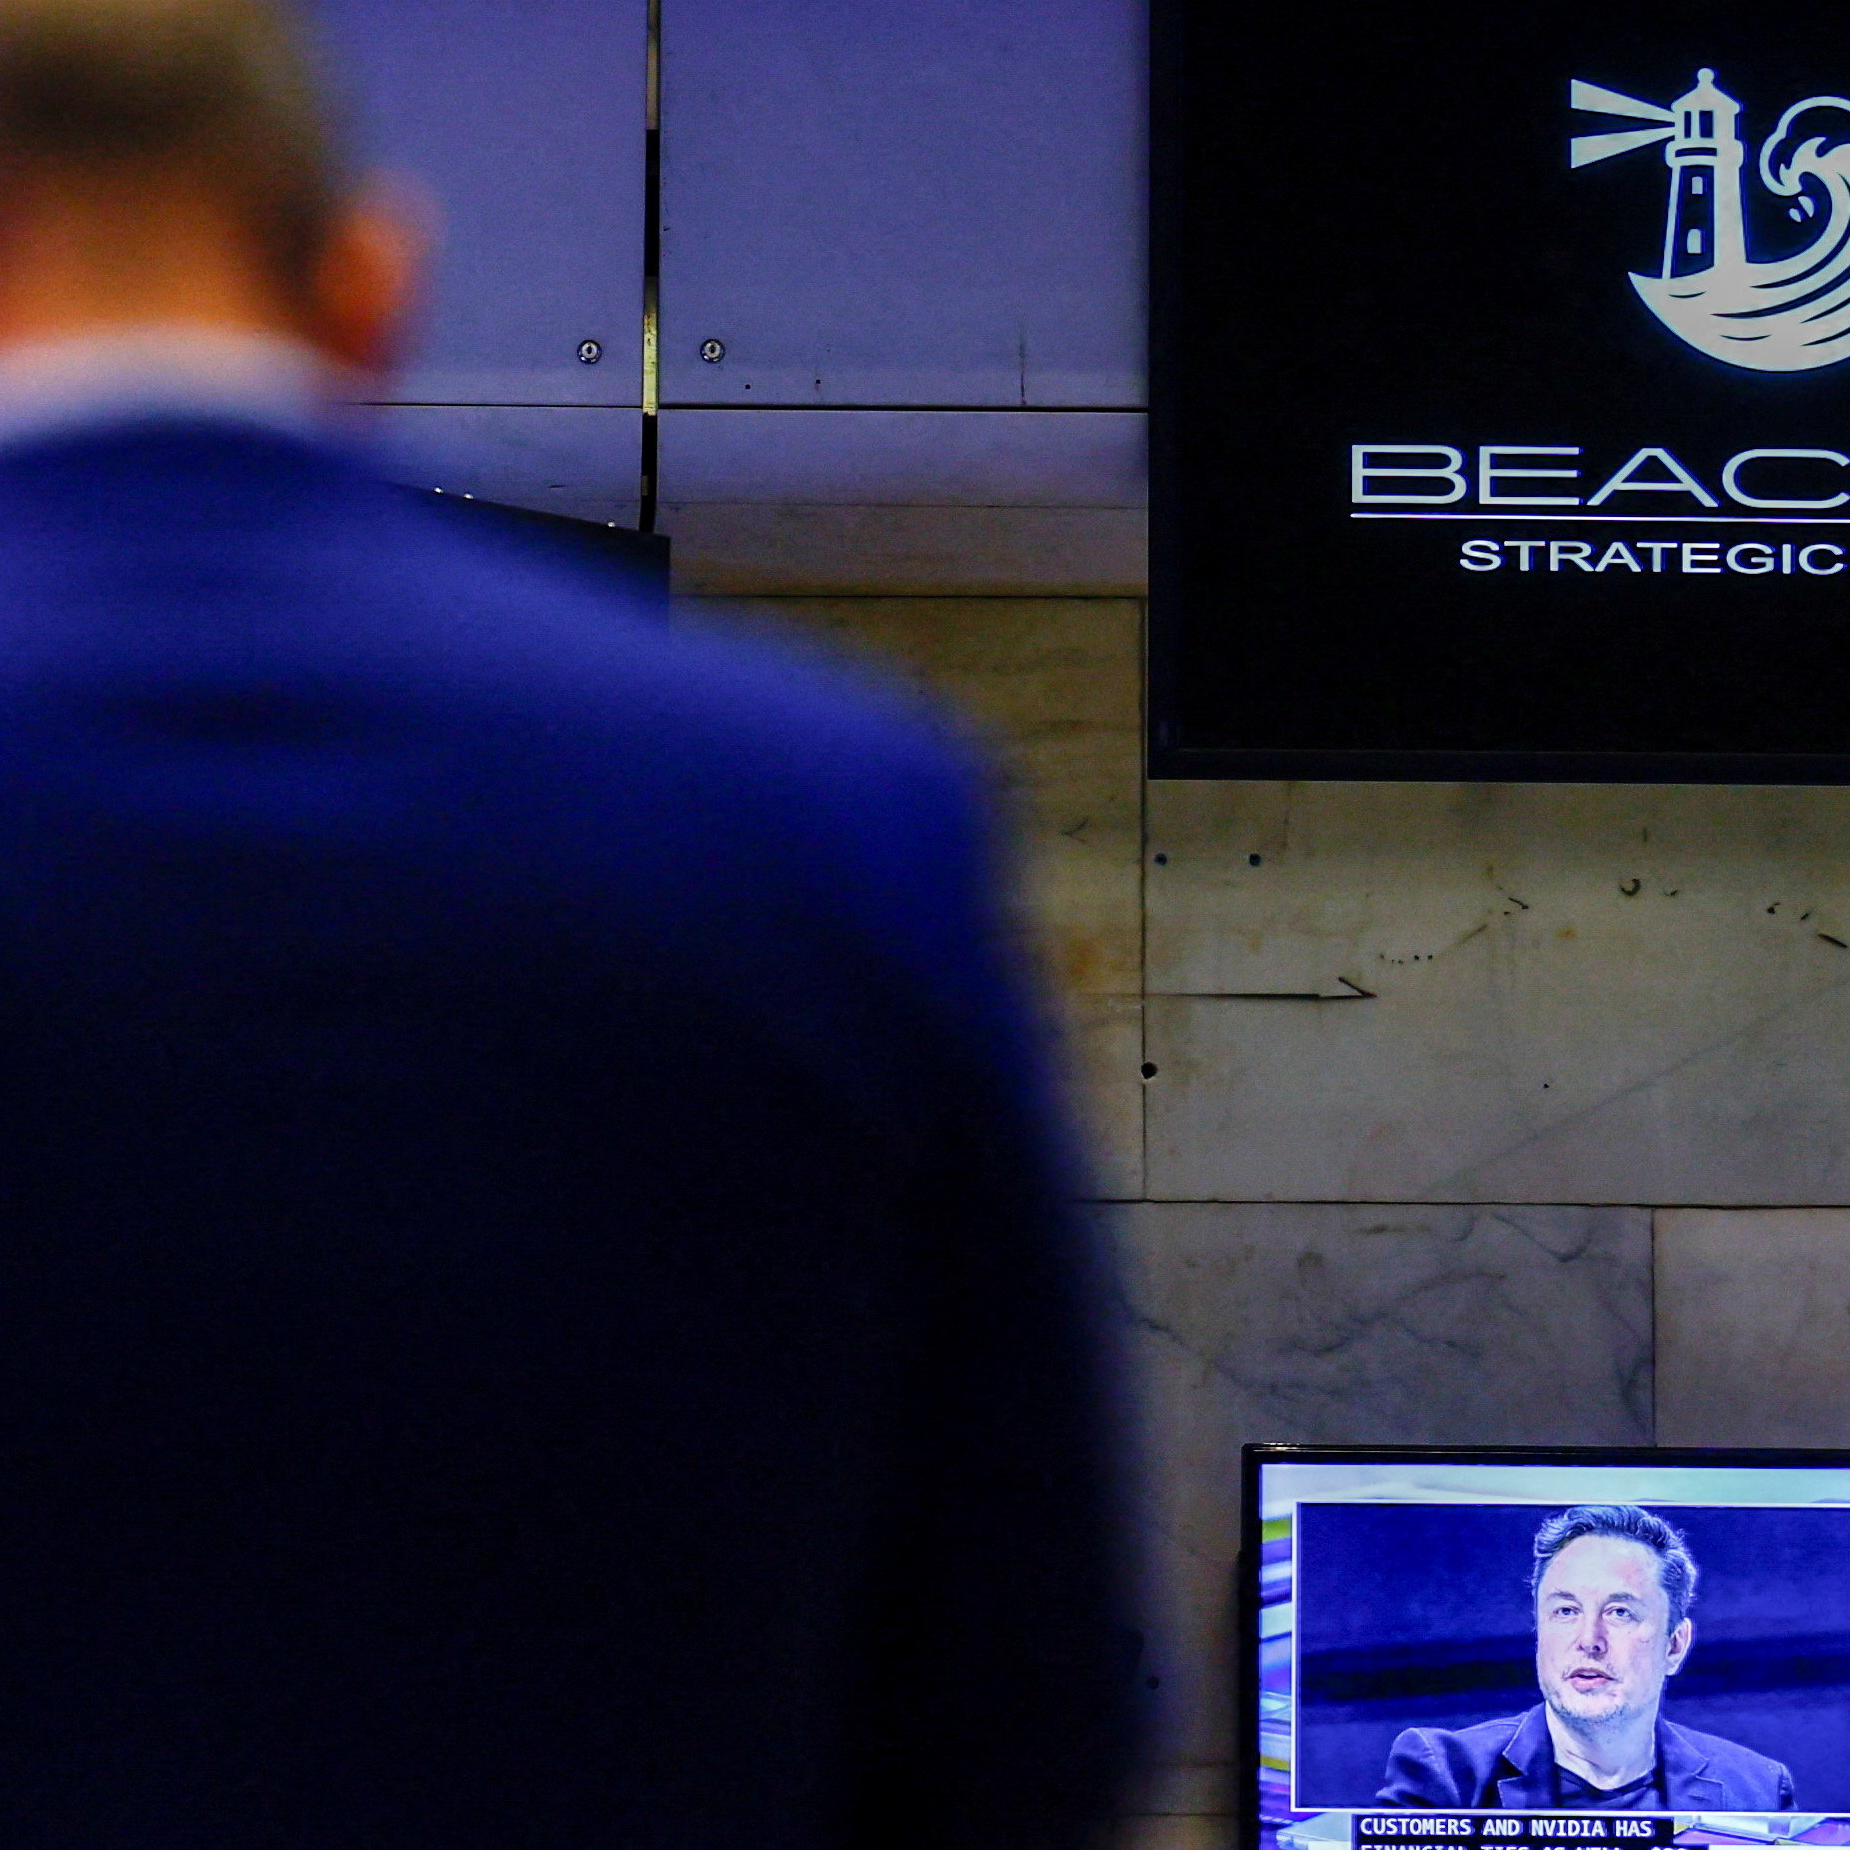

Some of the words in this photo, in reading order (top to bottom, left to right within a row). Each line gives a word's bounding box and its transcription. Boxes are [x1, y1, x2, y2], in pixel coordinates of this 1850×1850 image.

[1460, 540, 1847, 575] STRATEGIC
[1360, 1817, 1472, 1837] CUSTOMERS
[1483, 1819, 1521, 1836] AND
[1531, 1819, 1605, 1837] NVIDIA
[1615, 1820, 1652, 1837] HAS
